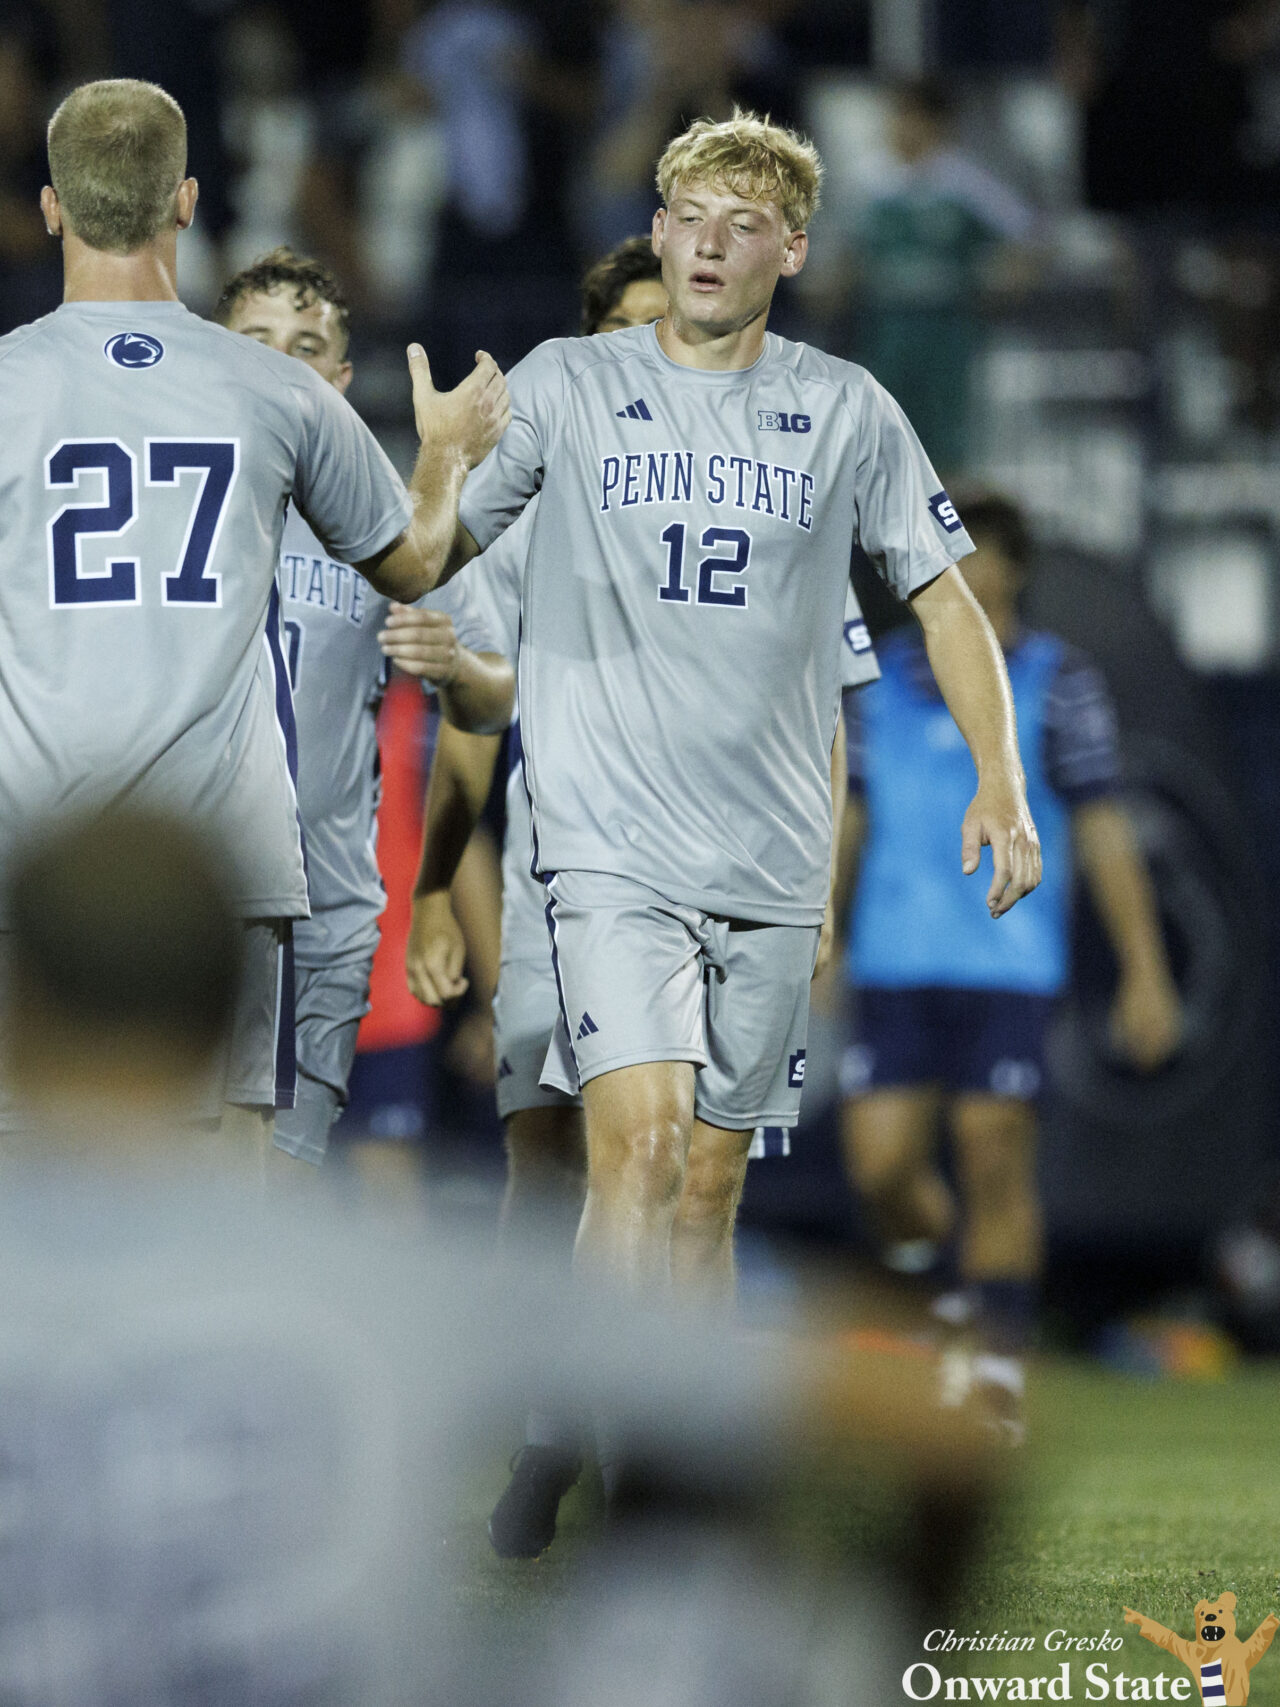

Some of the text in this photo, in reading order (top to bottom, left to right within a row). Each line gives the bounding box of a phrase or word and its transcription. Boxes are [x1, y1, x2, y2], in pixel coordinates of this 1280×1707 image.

[43, 437, 240, 610] 27
[599, 450, 815, 533] PENN STATE
[657, 520, 753, 609] 12
